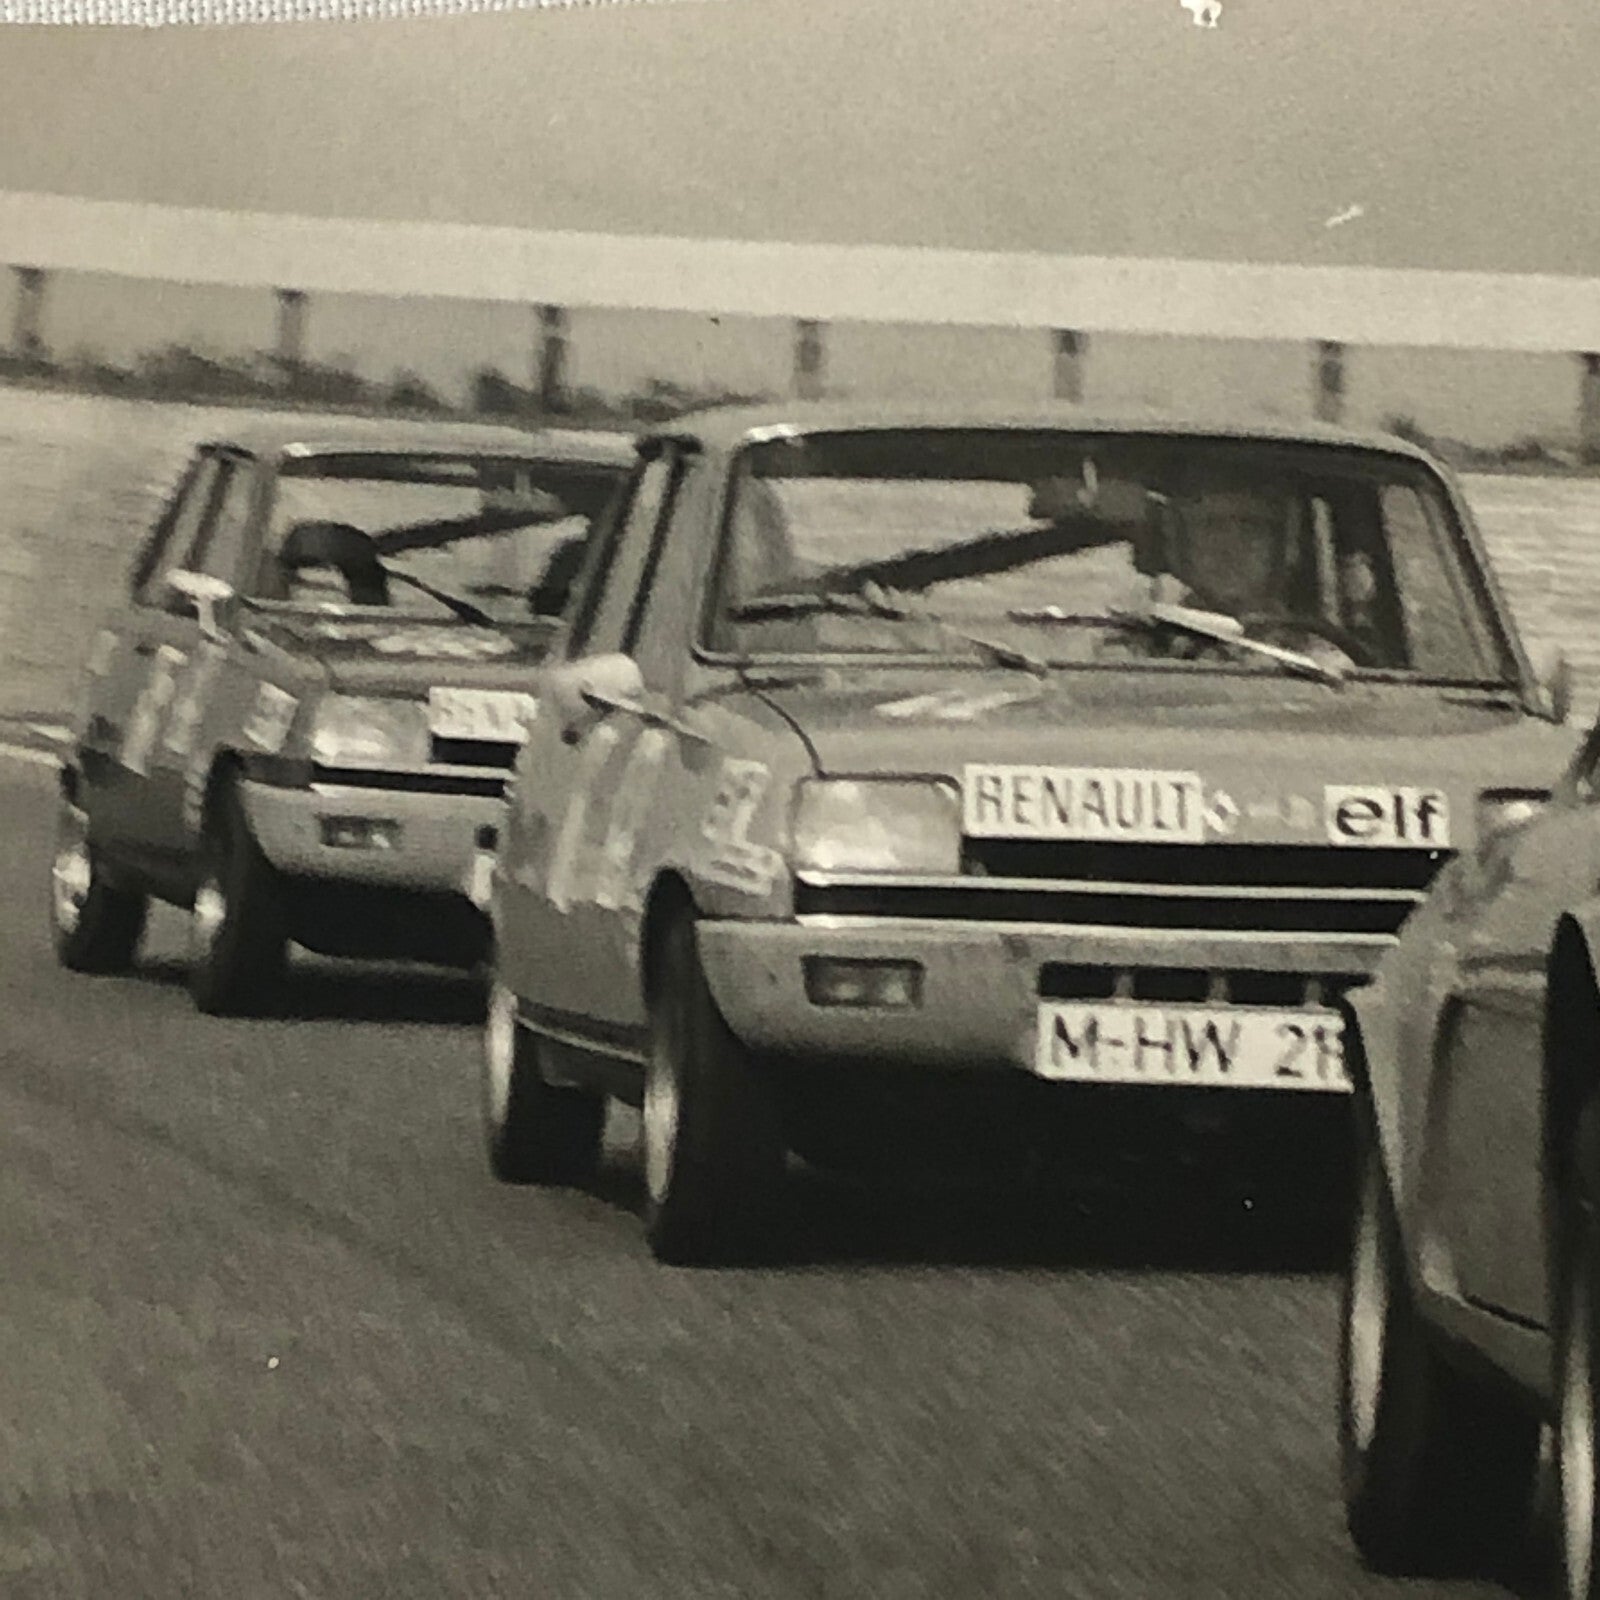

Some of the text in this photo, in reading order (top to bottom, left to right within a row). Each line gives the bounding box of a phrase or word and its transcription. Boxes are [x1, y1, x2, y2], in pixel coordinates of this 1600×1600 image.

[975, 773, 1192, 830] RENAULT
[1336, 794, 1438, 839] elf
[1051, 1013, 1242, 1074] M-HW
